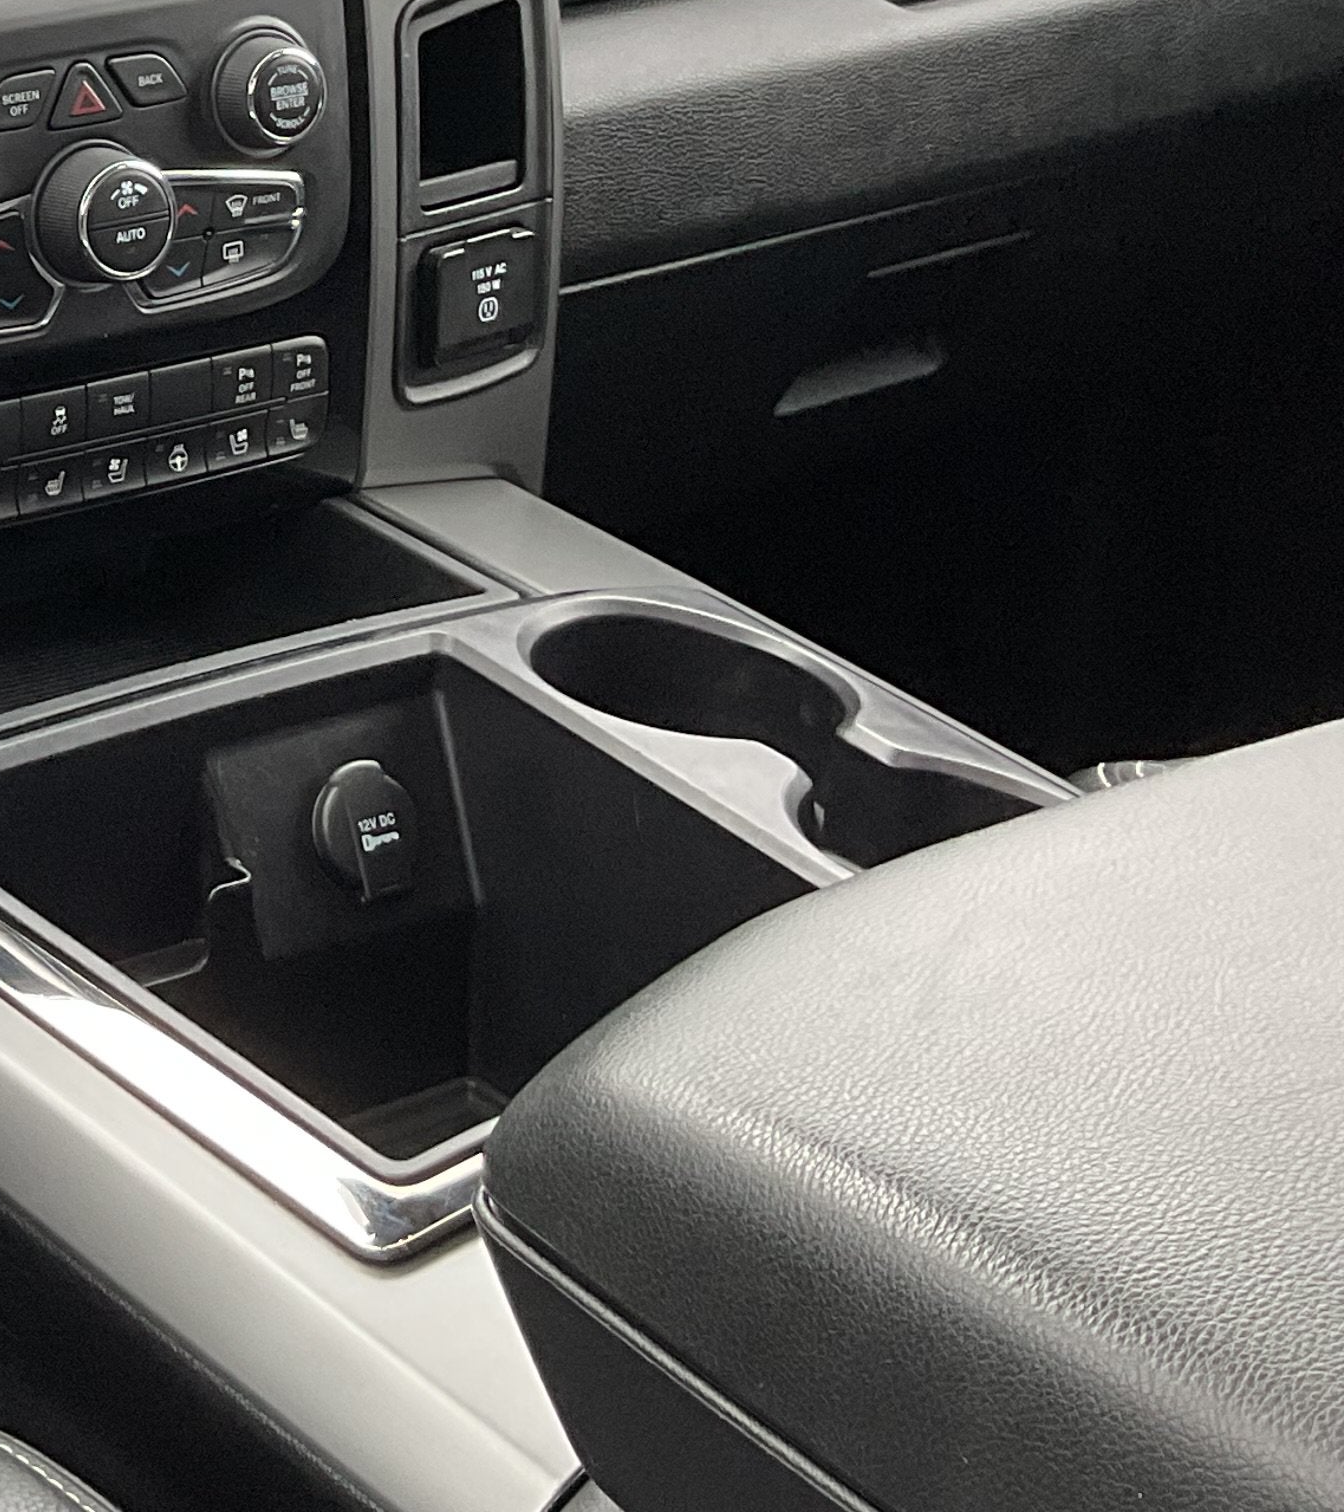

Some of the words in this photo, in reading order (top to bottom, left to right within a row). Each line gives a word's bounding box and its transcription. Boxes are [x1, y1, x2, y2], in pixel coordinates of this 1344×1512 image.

[138, 73, 163, 88] BACK
[270, 81, 308, 98] BROWSE
[2, 90, 40, 106] SCREEN
[276, 97, 305, 111] ENTER
[10, 103, 29, 117] OFF
[275, 116, 305, 129] SCROLL
[118, 195, 140, 210] OFF
[252, 191, 281, 205] FRONT
[116, 227, 146, 244] AUTO
[296, 368, 311, 380] OFF
[239, 382, 254, 393] OFF
[290, 379, 316, 392] FRONT
[235, 392, 256, 404] REAR
[51, 424, 68, 436] OFF
[358, 815, 377, 832] 12V
[378, 812, 396, 828] DC
